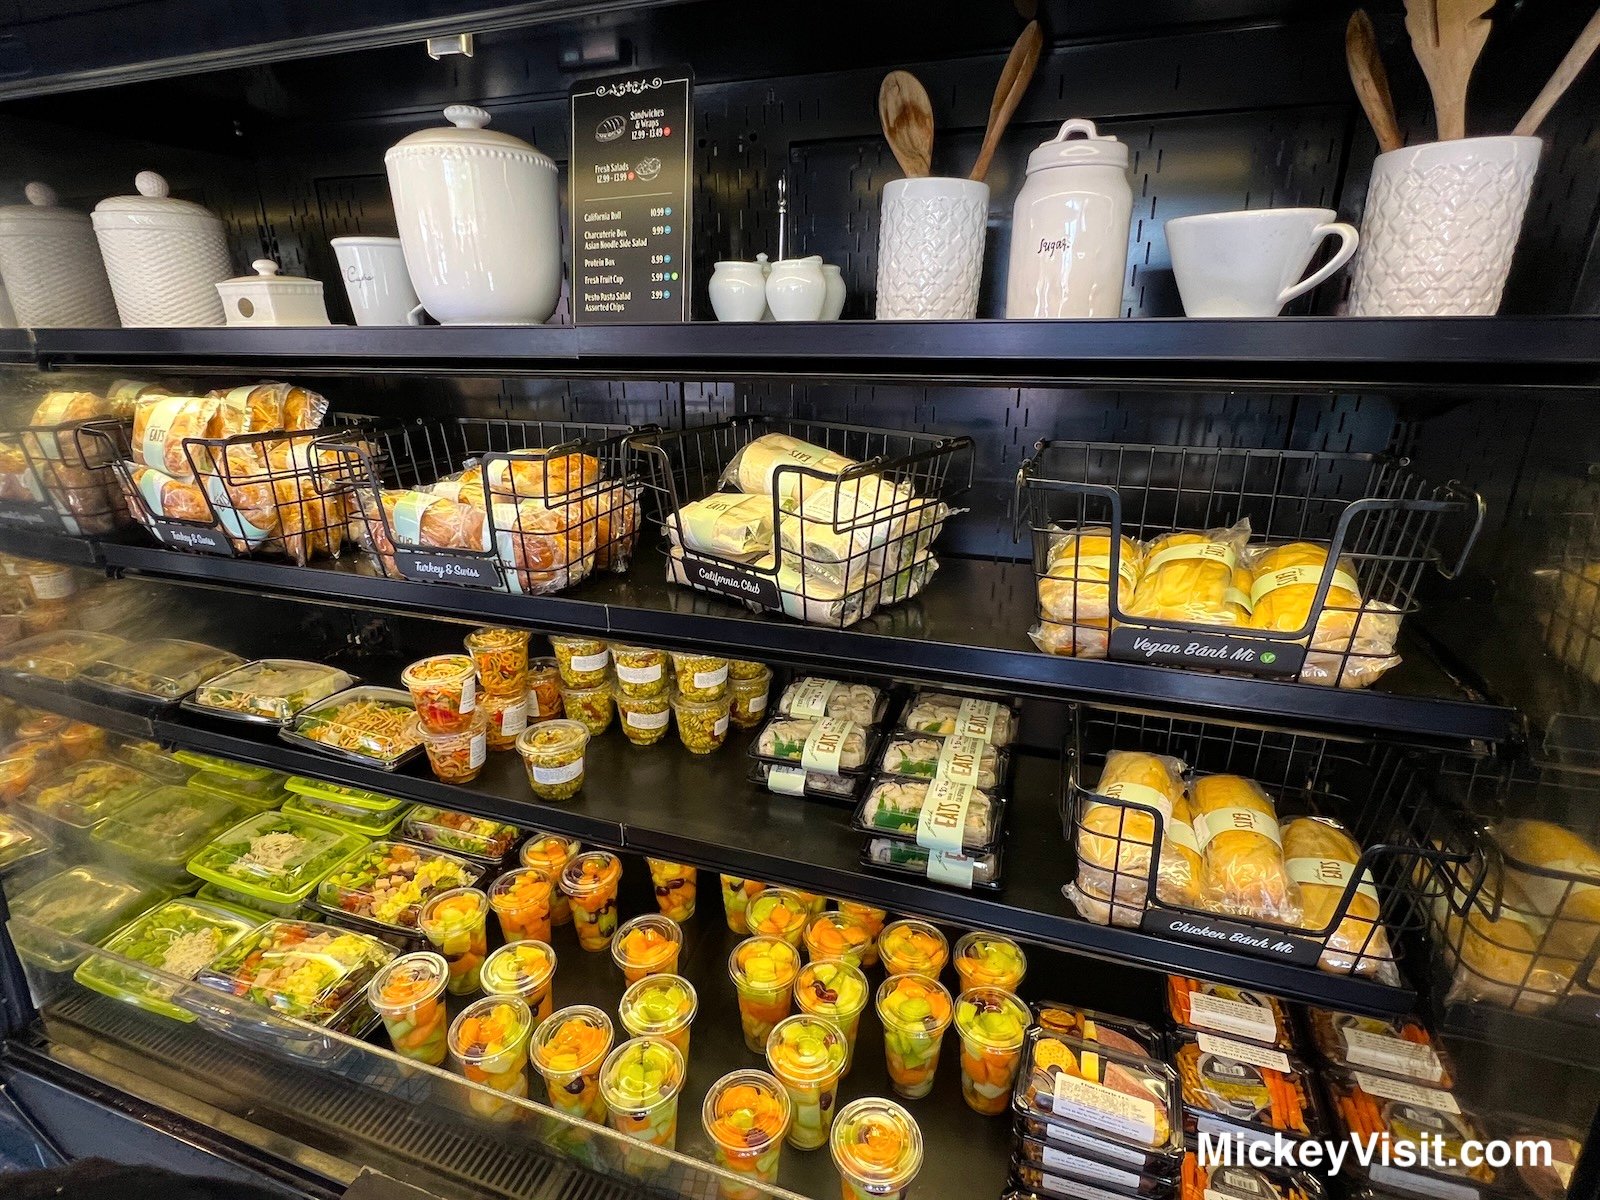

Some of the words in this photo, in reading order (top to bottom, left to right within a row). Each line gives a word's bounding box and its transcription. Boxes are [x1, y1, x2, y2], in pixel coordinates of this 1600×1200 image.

[630, 108, 665, 120] Sandwiches
[640, 120, 660, 130] Wraps
[631, 130, 646, 140] 12.99
[594, 164, 610, 174] Fresh
[610, 162, 629, 172] Salads
[596, 174, 610, 184] 12.99
[614, 172, 628, 182] 13.99
[584, 212, 610, 222] California
[610, 210, 622, 220] Roll
[650, 208, 664, 217] 10.99
[584, 230, 616, 240] Charcuterie
[616, 228, 628, 238] Box
[652, 226, 664, 236] 9.99
[584, 242, 600, 250] Asian
[600, 240, 619, 249] Noodle
[619, 239, 632, 248] Side
[632, 238, 648, 248] Salad
[584, 258, 604, 268] Protein
[604, 258, 616, 266] Box
[651, 254, 664, 264] 8.99
[584, 276, 600, 285] Fresh
[600, 275, 613, 284] Fruit
[612, 274, 624, 286] Cup
[651, 272, 664, 282] 5.99
[584, 292, 600, 302] Pesto
[600, 292, 616, 301] Pasta
[616, 292, 632, 301] Salad
[651, 290, 663, 300] 3.99
[584, 302, 610, 312] Assorted
[610, 302, 625, 312] Chips
[149, 428, 166, 442] EATS
[414, 561, 445, 578] Turkey
[445, 564, 453, 575] &
[454, 564, 480, 578] Swiss
[698, 567, 740, 588] California
[740, 580, 760, 594] Club
[1133, 637, 1181, 658] Vegan
[1184, 642, 1228, 659] Bánh
[968, 714, 989, 735] EATS
[816, 733, 840, 754] EATS
[950, 753, 975, 777] EATS
[934, 802, 961, 828] EATS
[1320, 861, 1343, 880] EATS
[1169, 920, 1226, 940] Chicken
[1228, 932, 1268, 949] Bánh
